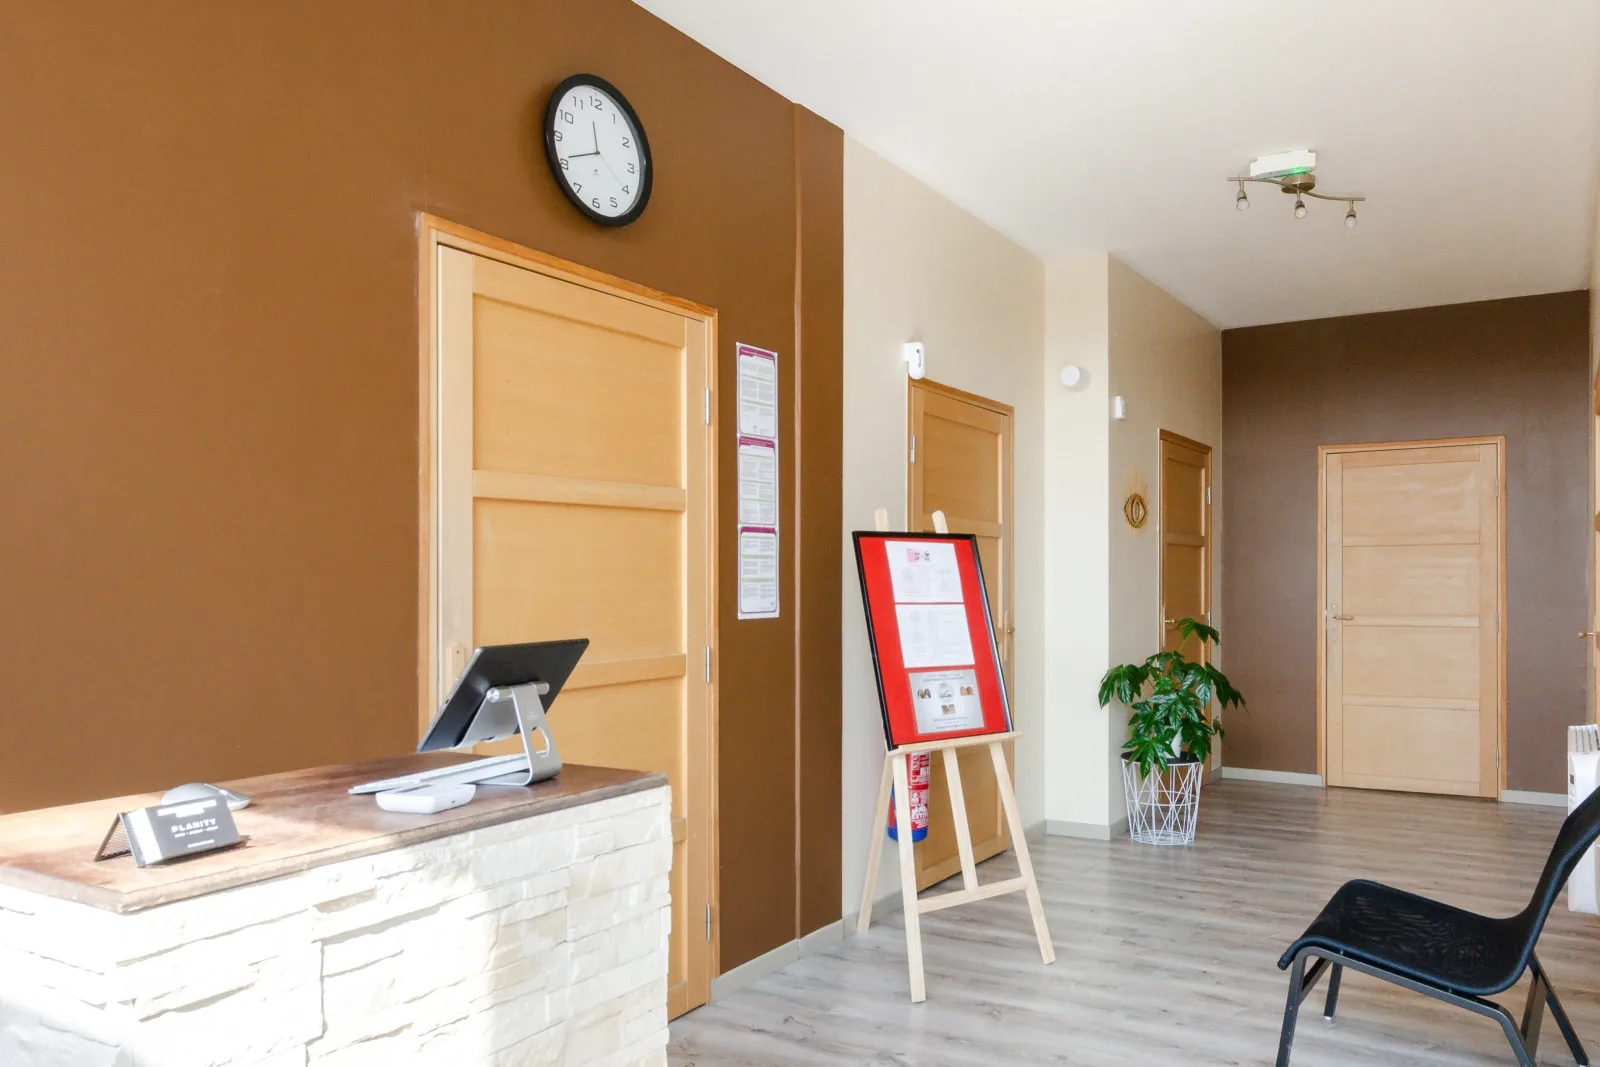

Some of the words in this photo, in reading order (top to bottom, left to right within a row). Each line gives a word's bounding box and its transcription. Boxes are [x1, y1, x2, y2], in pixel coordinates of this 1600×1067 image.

[573, 96, 584, 110] 11
[589, 96, 603, 111] 12
[559, 109, 574, 125] 10
[612, 113, 616, 124] 1
[554, 130, 563, 142] 9
[622, 137, 630, 148] 2
[560, 158, 569, 171] 8
[628, 163, 635, 174] 3
[573, 182, 582, 194] 7
[622, 185, 631, 195] 4
[592, 197, 601, 209] 6
[610, 197, 618, 208] 5
[171, 818, 216, 833] PLANITY
